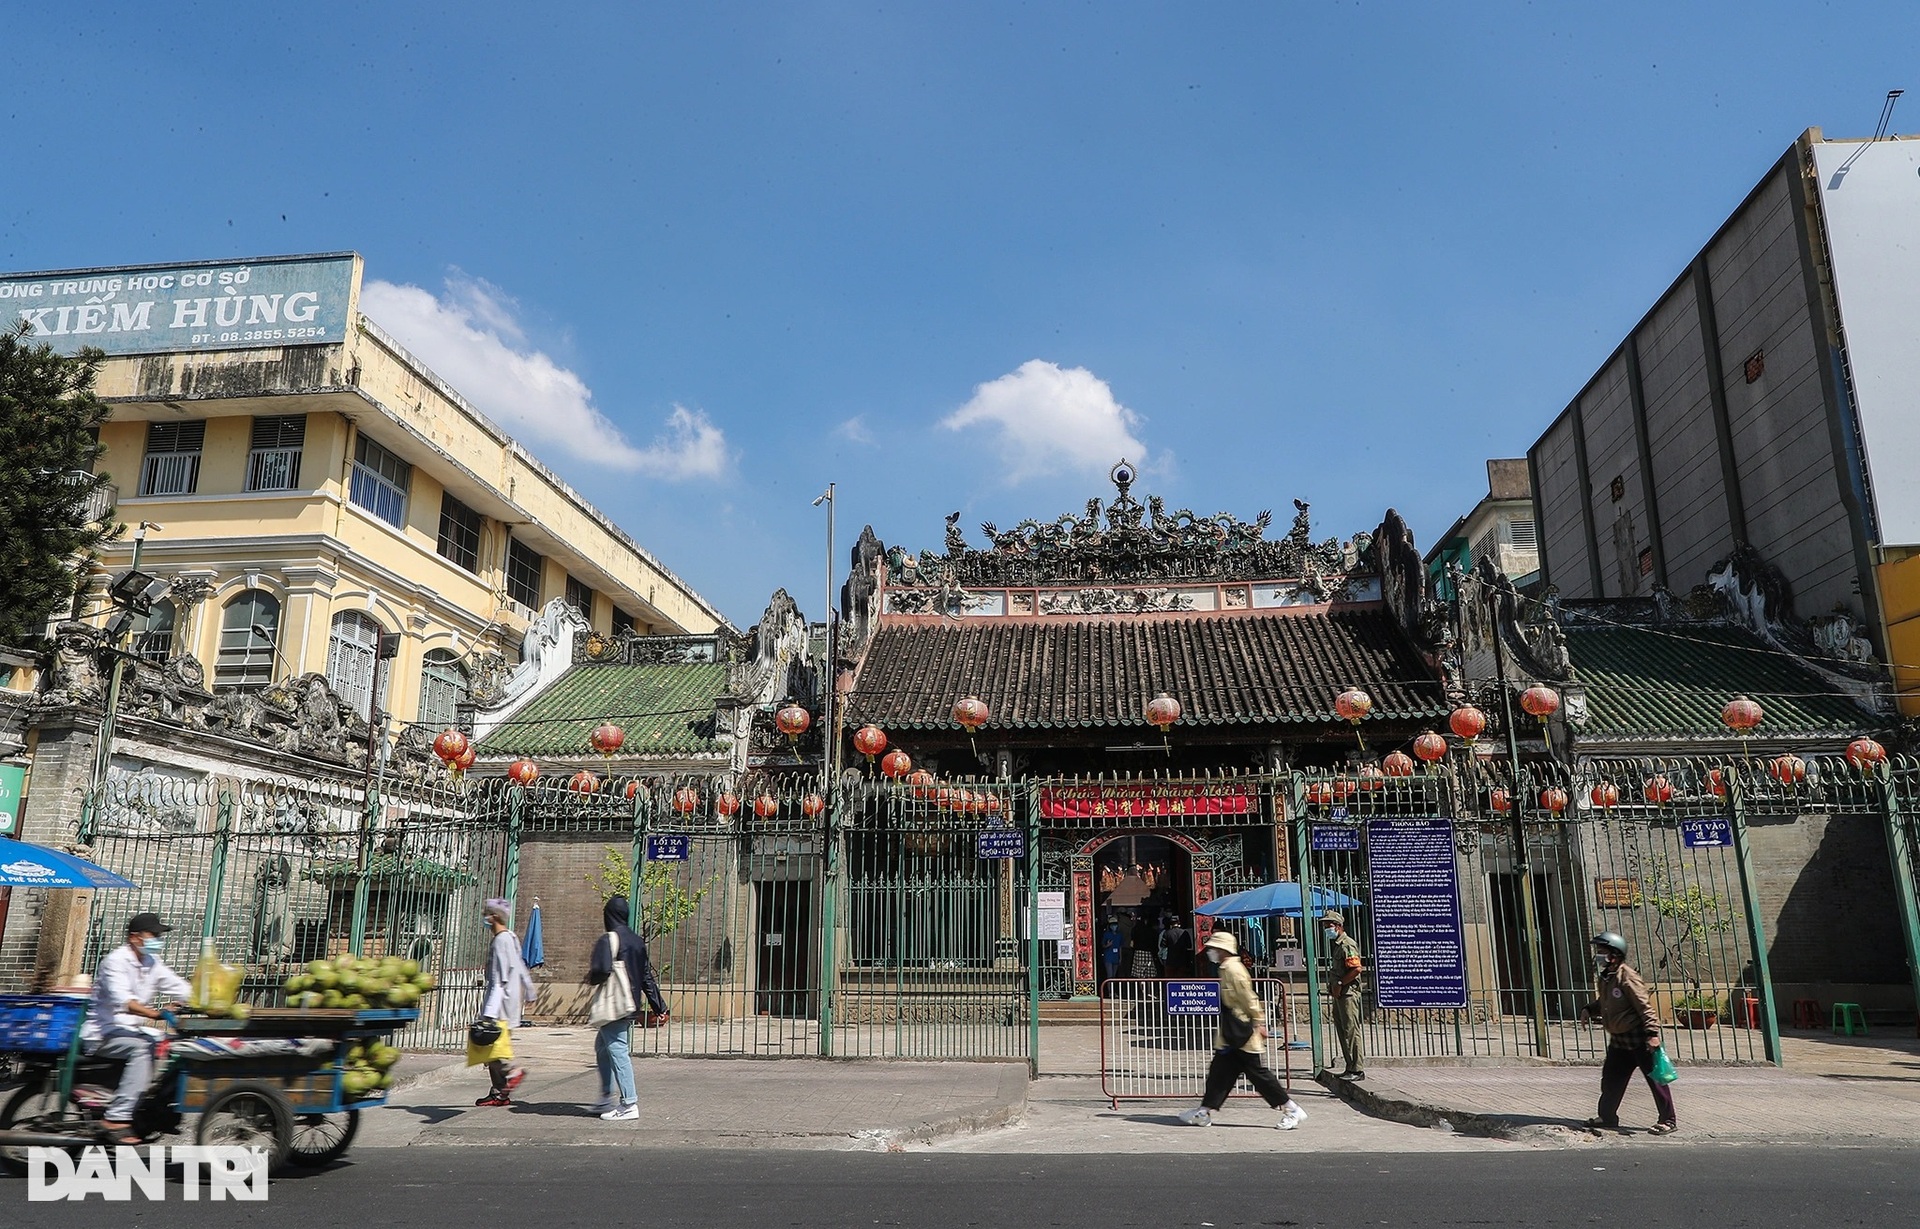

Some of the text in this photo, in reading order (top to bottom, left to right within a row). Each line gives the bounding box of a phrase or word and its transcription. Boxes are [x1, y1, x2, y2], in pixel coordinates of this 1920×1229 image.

[50, 279, 122, 295] TRUNG
[127, 275, 174, 293] HỌC
[180, 270, 214, 287] CƠ
[218, 265, 251, 285] SỞ
[19, 285, 320, 336] KIẾM HÙNG
[220, 327, 326, 342] 08.3855.5254
[1333, 808, 1346, 816] 710
[1685, 821, 1725, 831] LỐI VÀO
[654, 837, 668, 845] LỐI
